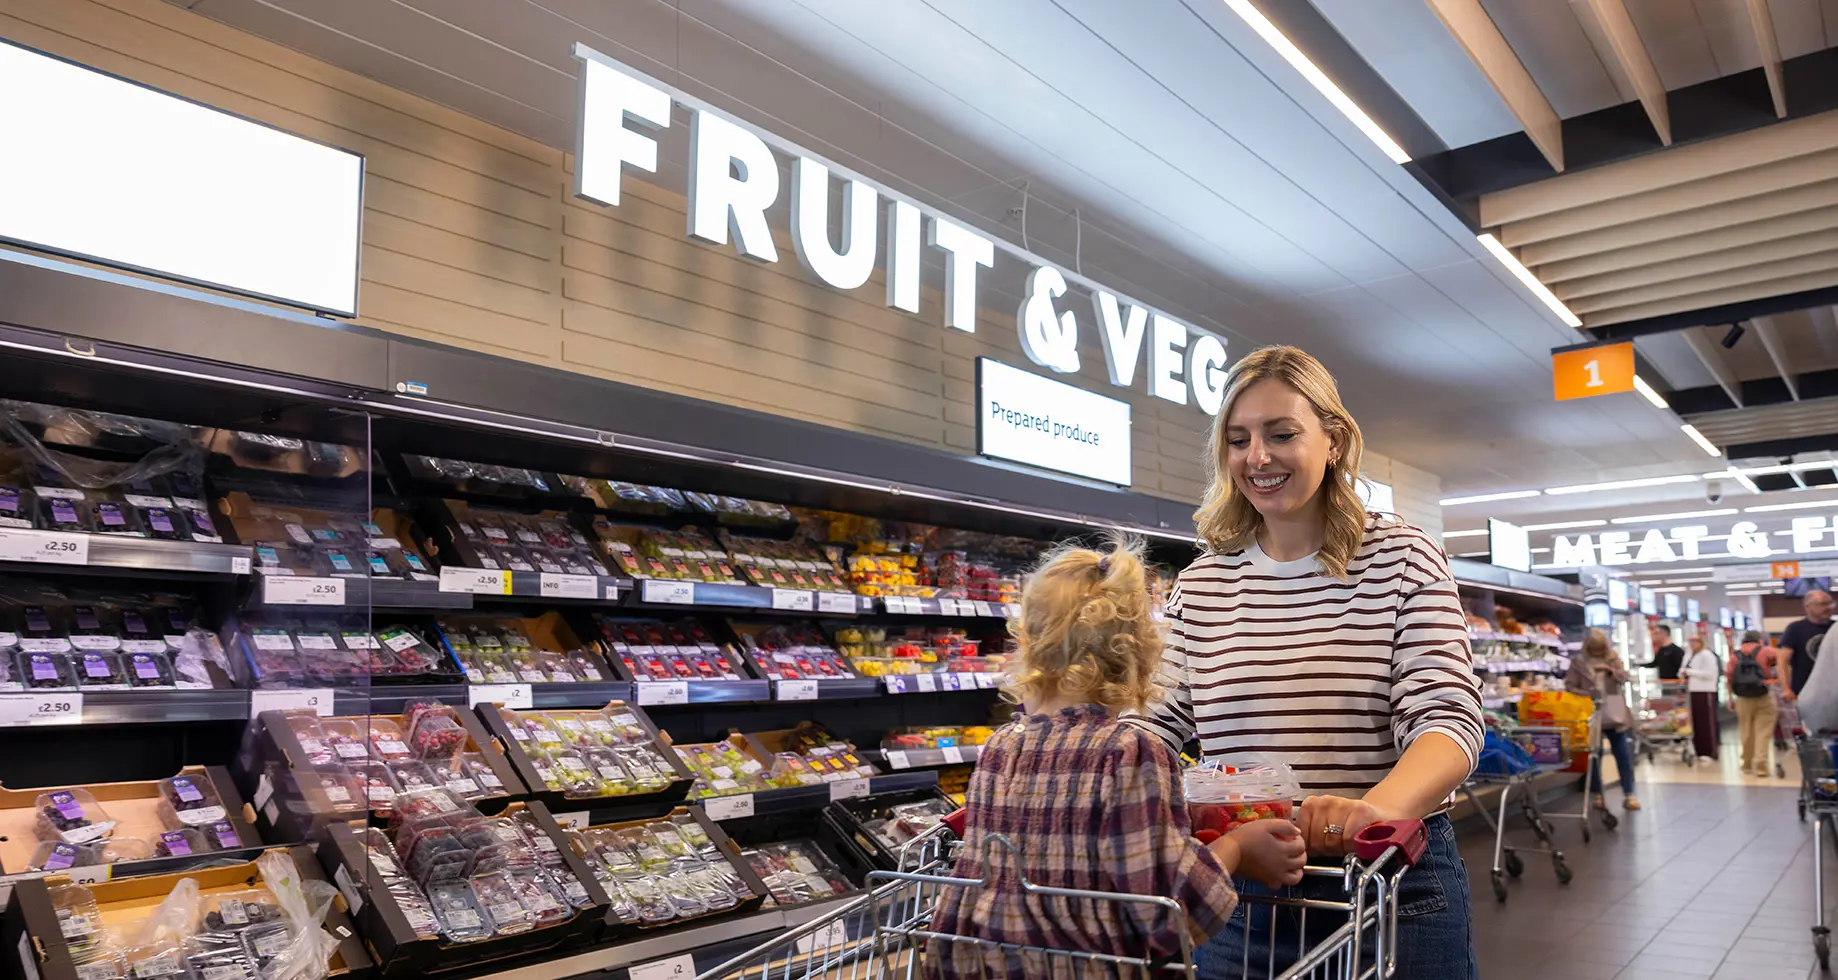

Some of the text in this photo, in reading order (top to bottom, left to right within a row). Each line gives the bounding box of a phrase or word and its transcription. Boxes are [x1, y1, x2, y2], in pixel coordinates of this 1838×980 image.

[576, 57, 1231, 416] FRUIT & VEG
[1583, 359, 1605, 387] 1
[991, 401, 1100, 446] Prepared produce
[45, 540, 78, 552] £2.50
[1553, 515, 1838, 568] MEAT & F
[478, 576, 498, 585] £2.50
[313, 585, 337, 594] £2.50
[512, 689, 520, 697] £2
[307, 696, 318, 706] £3
[38, 702, 71, 713] £2.50
[568, 819, 578, 828] £2
[674, 964, 683, 975] £2
